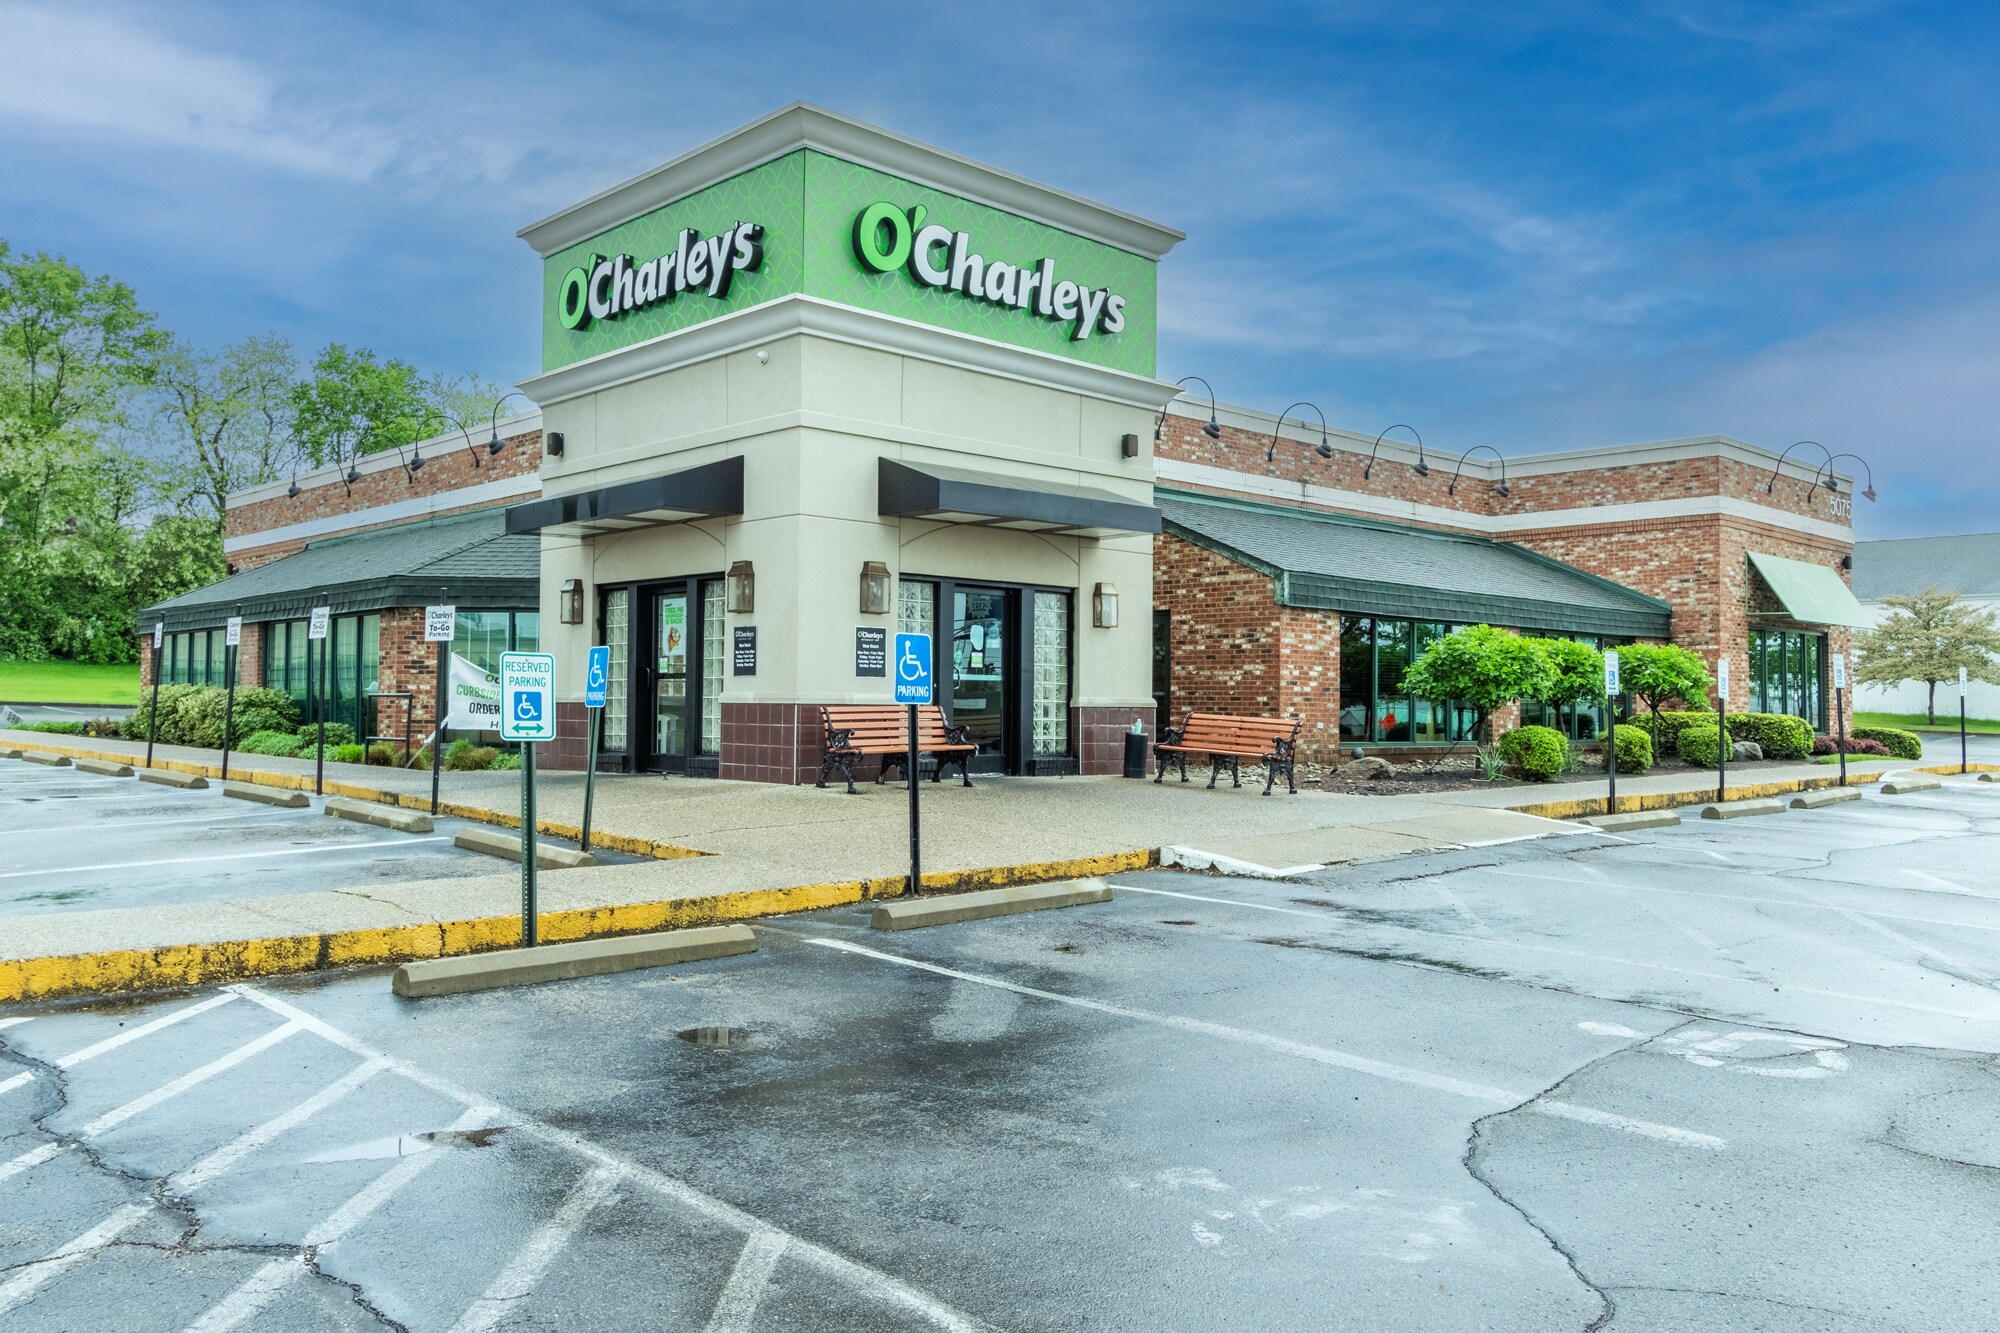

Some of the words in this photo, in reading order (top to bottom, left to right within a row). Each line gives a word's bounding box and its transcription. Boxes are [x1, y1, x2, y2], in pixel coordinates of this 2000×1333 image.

[558, 220, 764, 331] O'Charley's
[853, 201, 1126, 341] O'Charley's
[1830, 496, 1851, 519] 5075
[505, 661, 550, 673] RESERVED
[509, 676, 546, 687] PARKING
[587, 691, 604, 701] PARKING
[897, 685, 929, 698] PARKING
